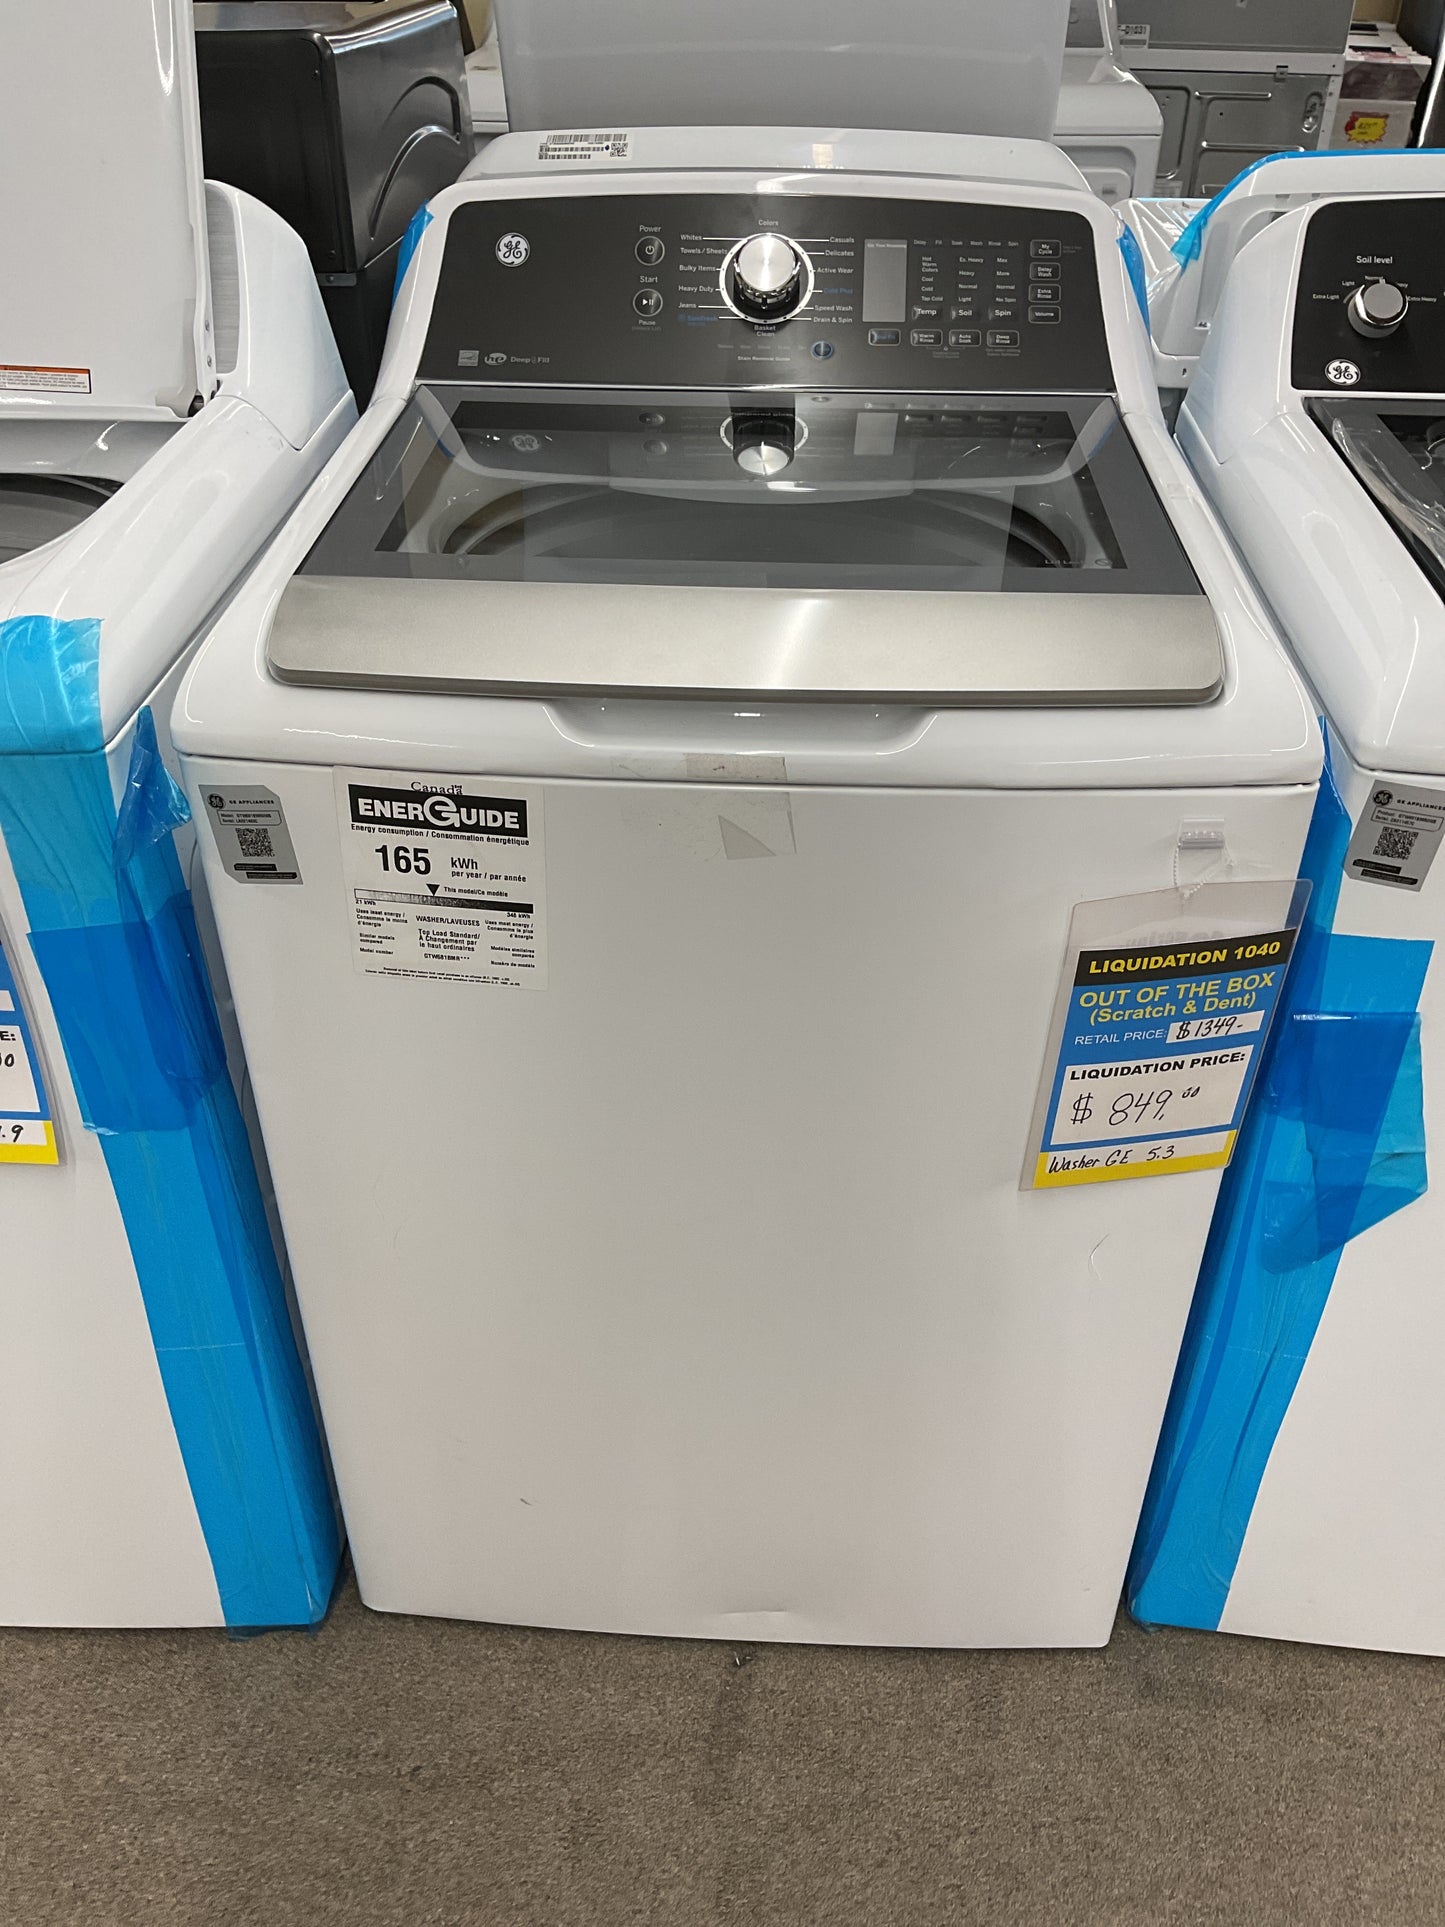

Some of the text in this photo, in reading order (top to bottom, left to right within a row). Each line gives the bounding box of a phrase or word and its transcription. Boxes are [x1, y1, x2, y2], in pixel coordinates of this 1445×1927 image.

[1356, 256, 1393, 264] Soil level
[917, 308, 937, 316] Temp
[411, 781, 463, 795] Canada
[358, 795, 519, 829] ENERGUIDE
[351, 824, 376, 833] Energy
[378, 827, 424, 837] consumption
[431, 831, 484, 842] Consommation
[486, 836, 529, 846] énergétique
[375, 845, 431, 875] 165
[451, 857, 478, 870] kWh
[504, 874, 527, 882] année
[415, 915, 480, 926] WASHER/LAVEUSES
[432, 929, 447, 937] Load
[443, 944, 475, 952] ordinaires
[1089, 941, 1281, 974] LIQUIDATION 1040
[1079, 972, 1276, 1007] OUT OF THE BOX
[1090, 992, 1256, 1026] (Scratch & Dent)
[1074, 1033, 1118, 1045] RETAIL
[1123, 1029, 1167, 1041] PRICE:
[1070, 1052, 1246, 1081] LIQUIDATION PRICE:
[1048, 1145, 1175, 1174] Washer GE 5.3
